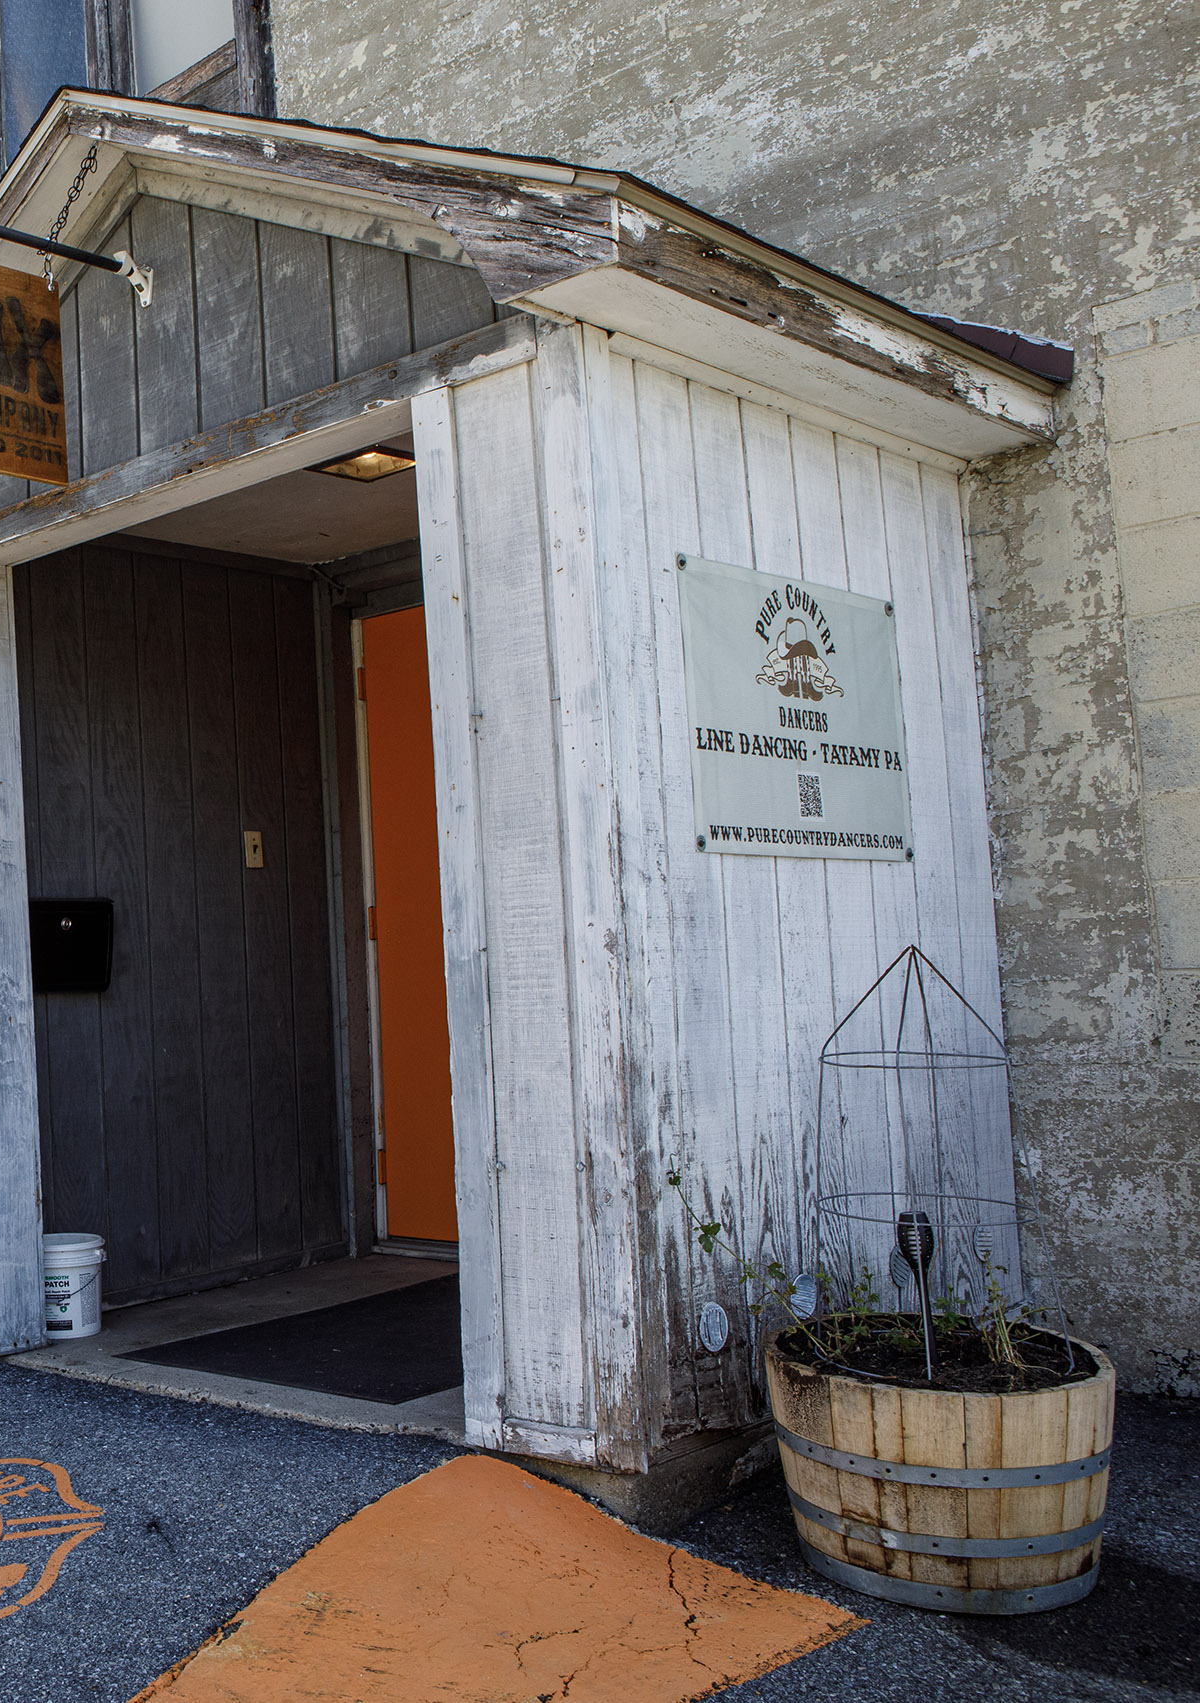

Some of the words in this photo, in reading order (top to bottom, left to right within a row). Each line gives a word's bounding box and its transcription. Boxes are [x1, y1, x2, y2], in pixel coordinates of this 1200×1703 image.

[755, 590, 783, 645] PURE
[785, 583, 836, 656] COUNTRY
[778, 706, 828, 733] DANCERS
[695, 727, 735, 753] LINE
[739, 733, 807, 762] DANCING
[820, 743, 880, 770] TATAMY
[885, 750, 902, 772] PA
[709, 824, 904, 850] WWW.PURECOUNTRYDANCERS.COM
